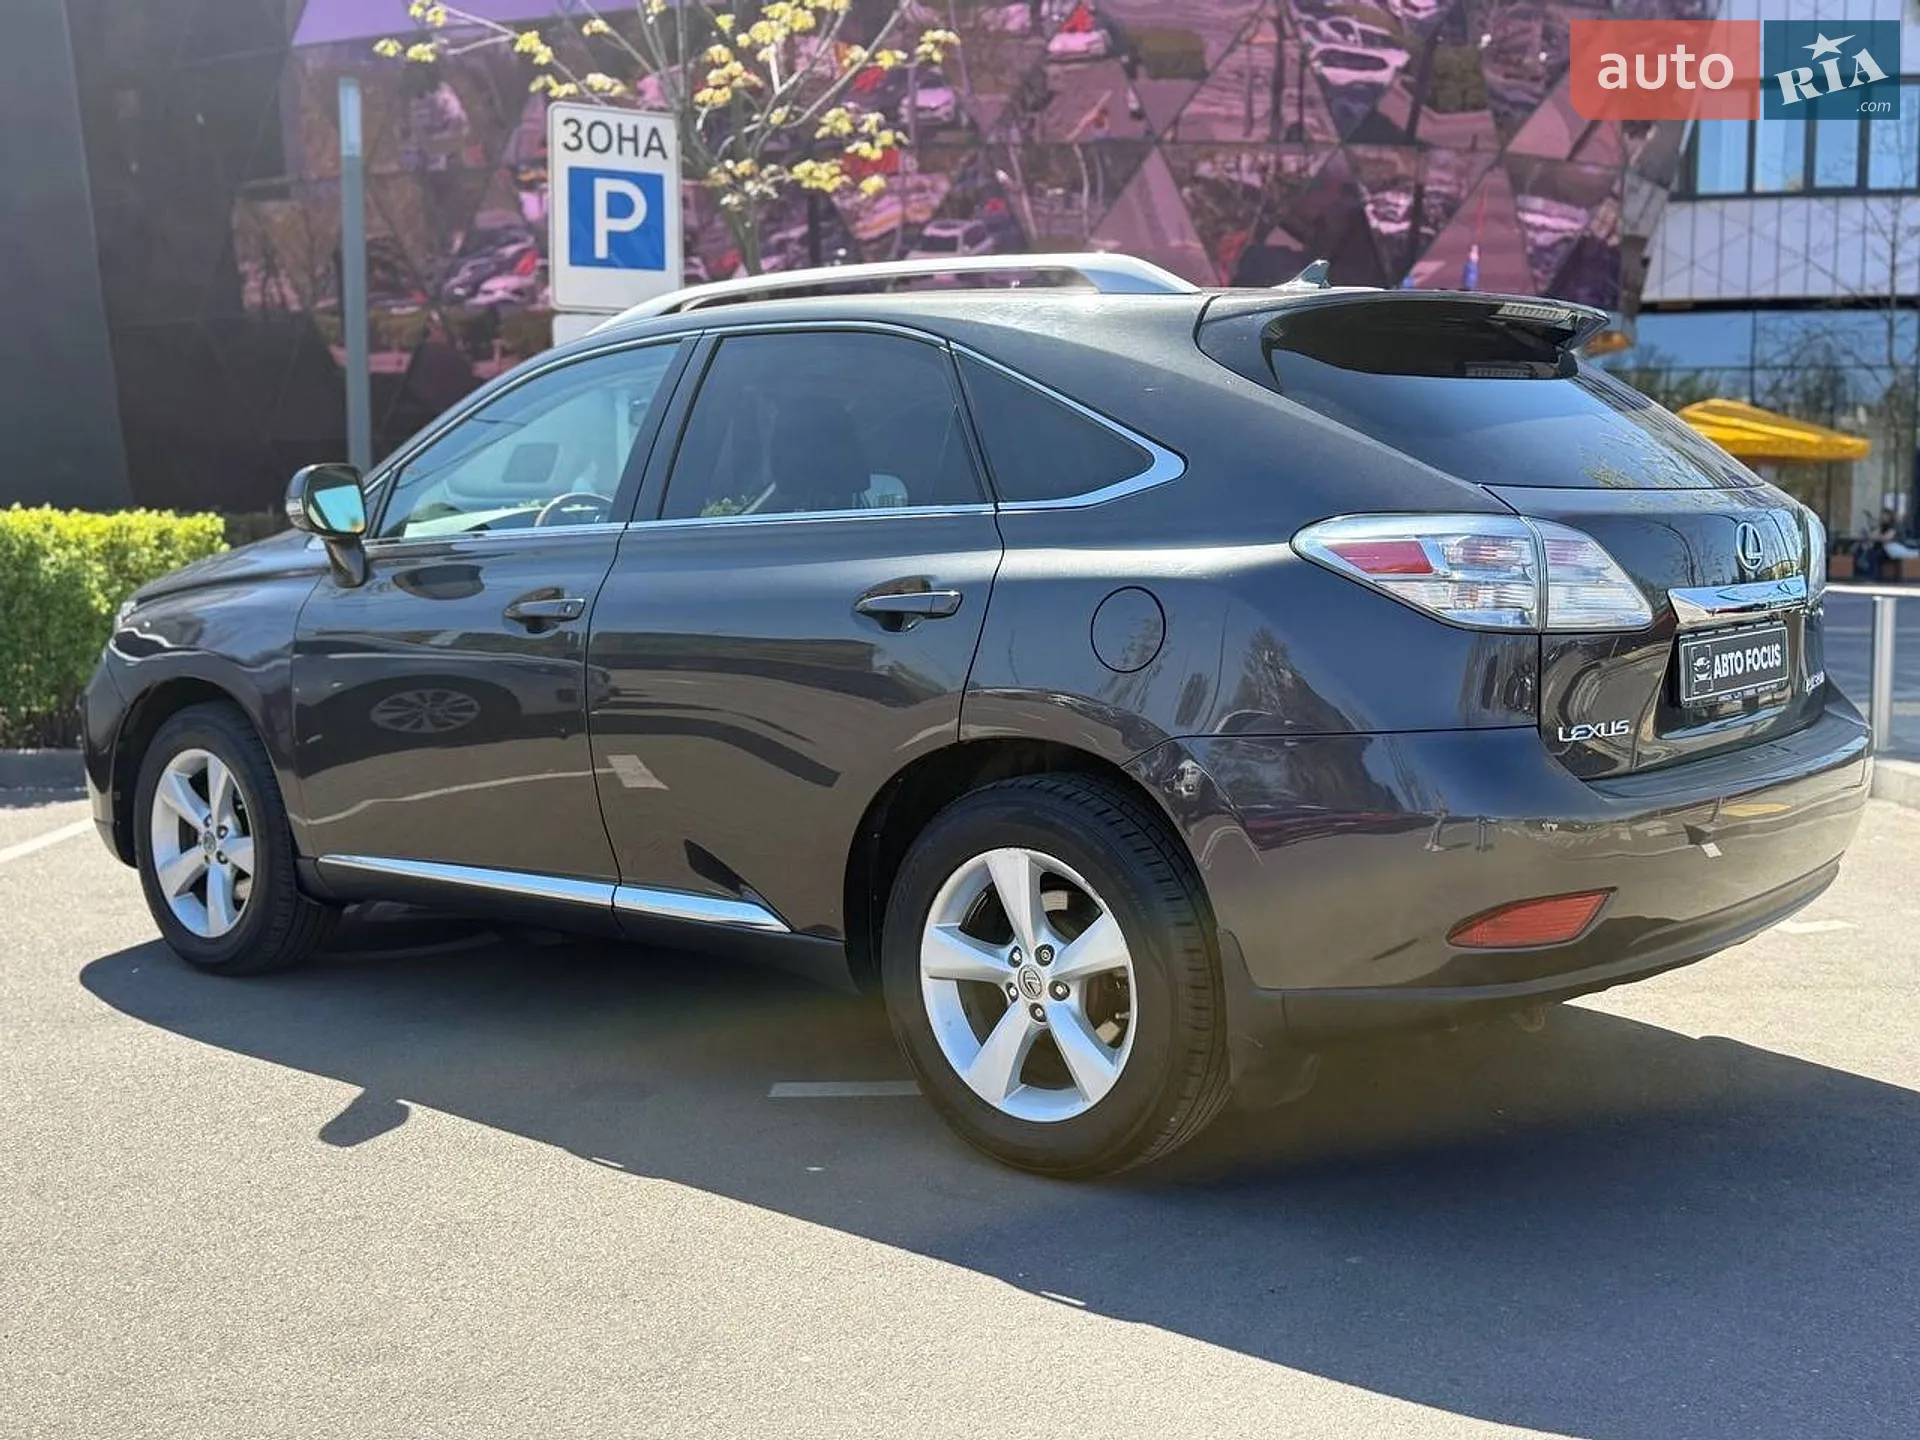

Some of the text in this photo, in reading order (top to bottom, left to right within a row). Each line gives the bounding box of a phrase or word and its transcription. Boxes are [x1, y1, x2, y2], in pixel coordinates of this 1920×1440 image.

[562, 118, 668, 160] ЗОНА
[593, 177, 647, 260] P
[1745, 643, 1781, 673] FOCUS
[1558, 719, 1630, 742] LEXUS
